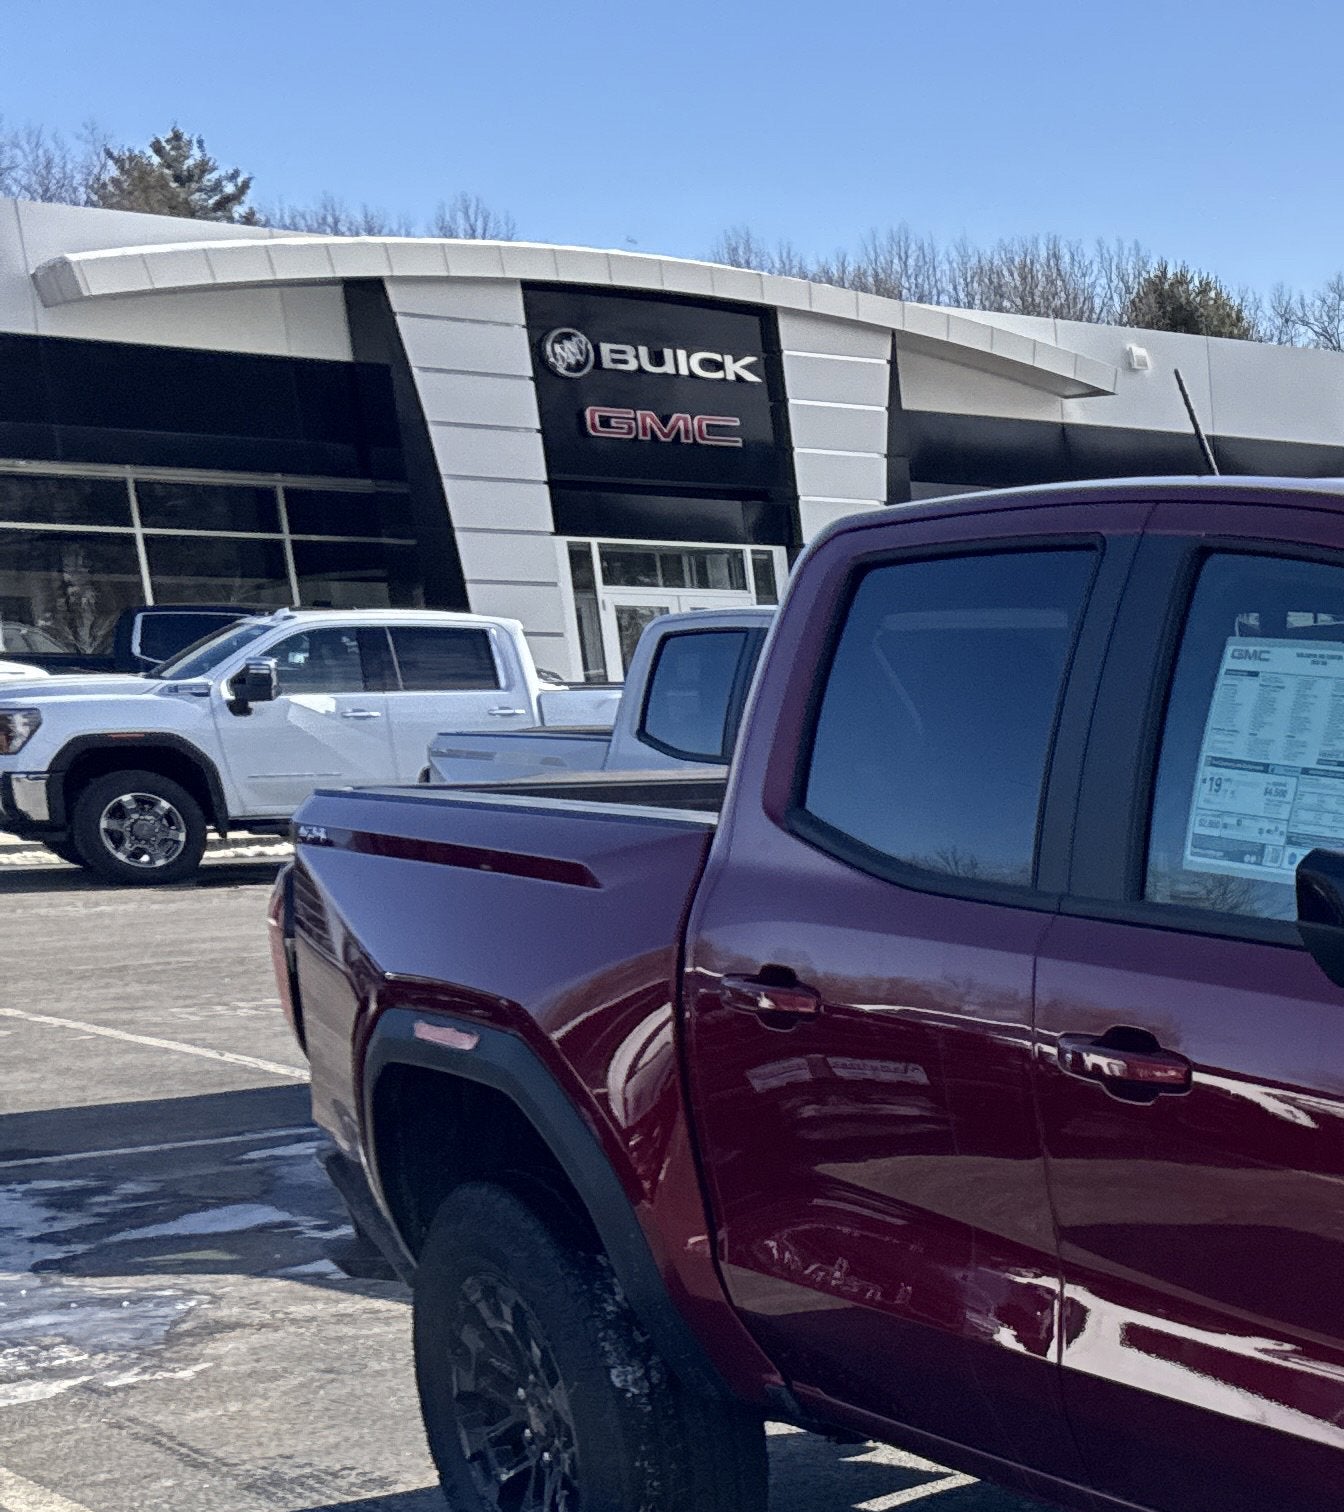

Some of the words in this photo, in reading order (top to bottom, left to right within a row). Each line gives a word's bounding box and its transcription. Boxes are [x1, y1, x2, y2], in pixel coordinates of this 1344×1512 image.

[600, 342, 762, 383] BUICK
[584, 406, 743, 448] GMC
[1230, 648, 1271, 662] GMC
[1208, 776, 1223, 793] 19
